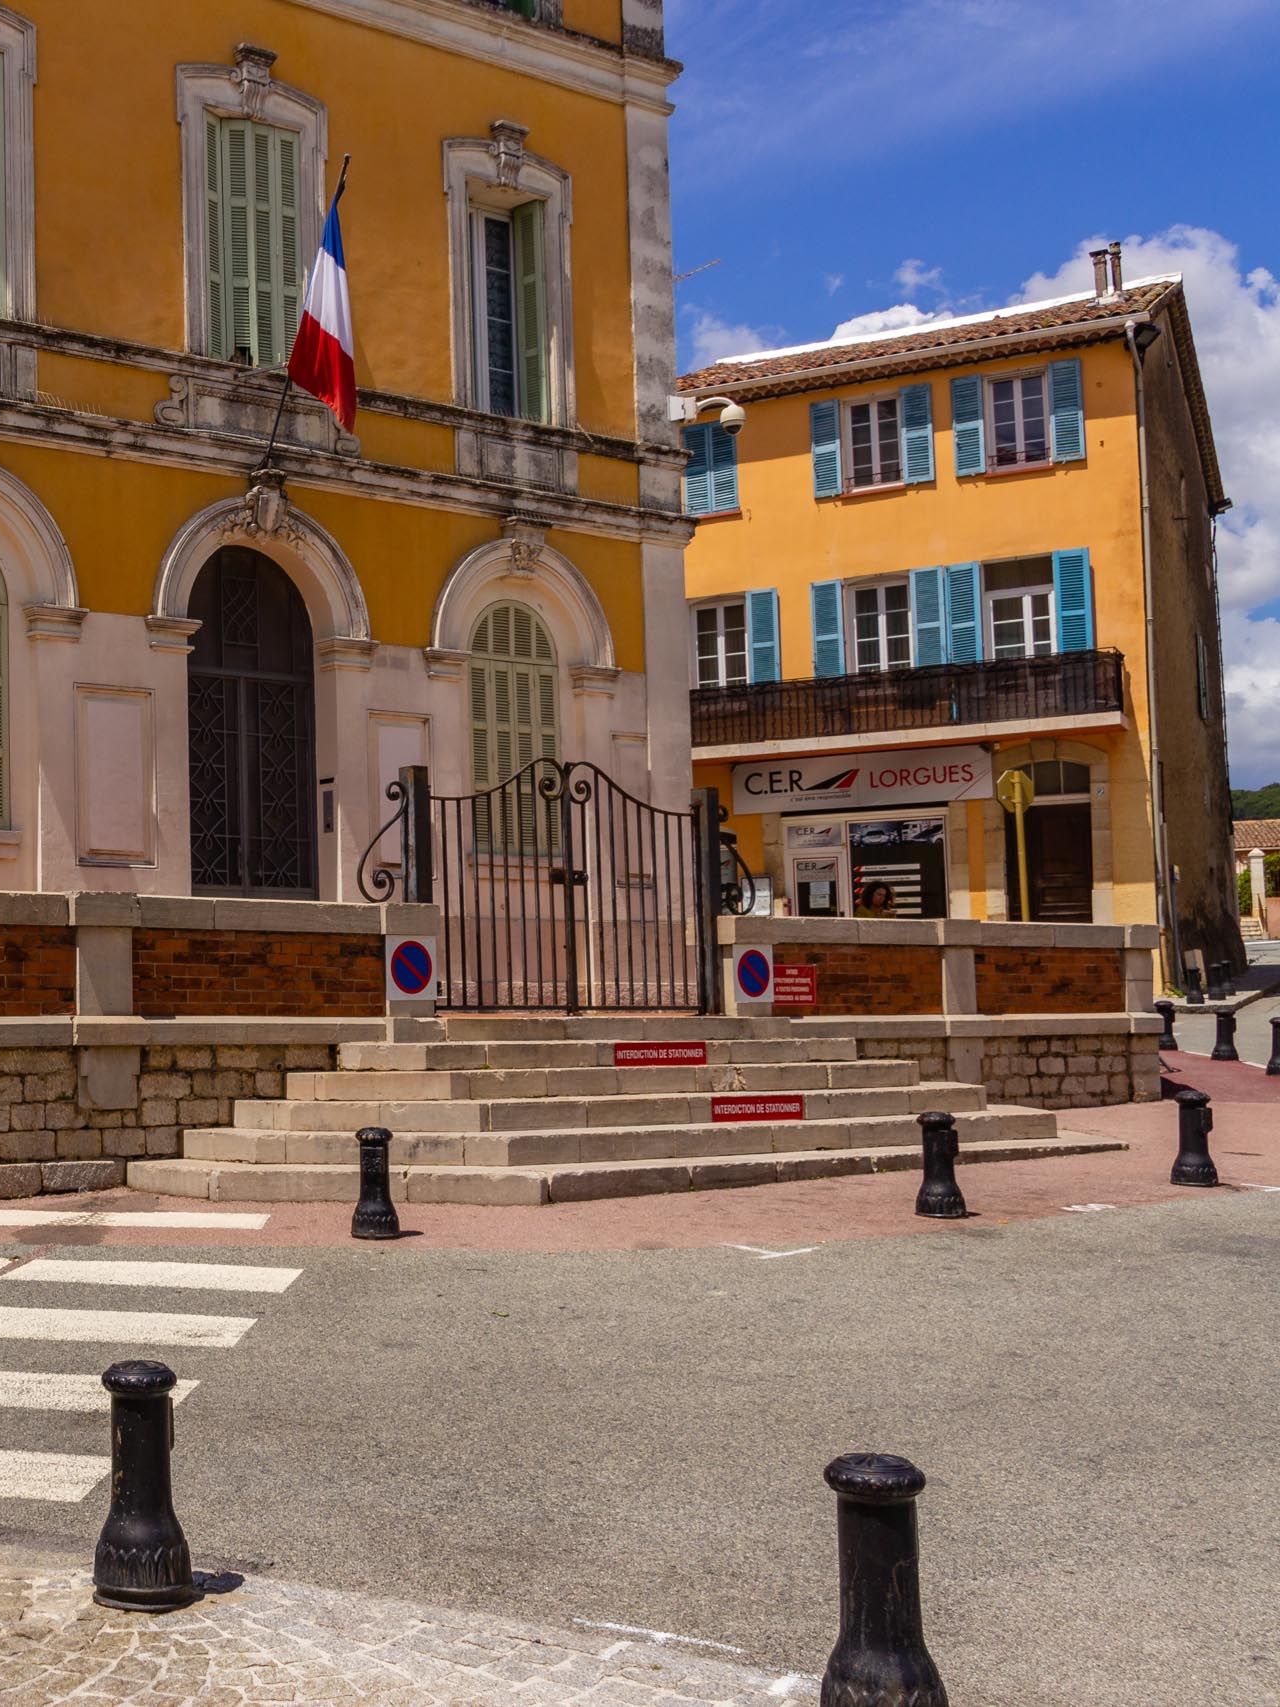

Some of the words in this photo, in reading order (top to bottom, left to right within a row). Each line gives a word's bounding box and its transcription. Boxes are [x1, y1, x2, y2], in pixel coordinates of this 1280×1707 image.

[744, 770, 804, 795] C.E.R
[869, 764, 974, 788] LORGUES
[616, 1050, 658, 1059] INTERDICTION
[659, 1050, 667, 1059] DE
[668, 1048, 704, 1058] STATIONNER
[714, 1104, 755, 1114] INTERDICTION
[756, 1104, 764, 1113] DE
[765, 1103, 801, 1113] STATIONNER
